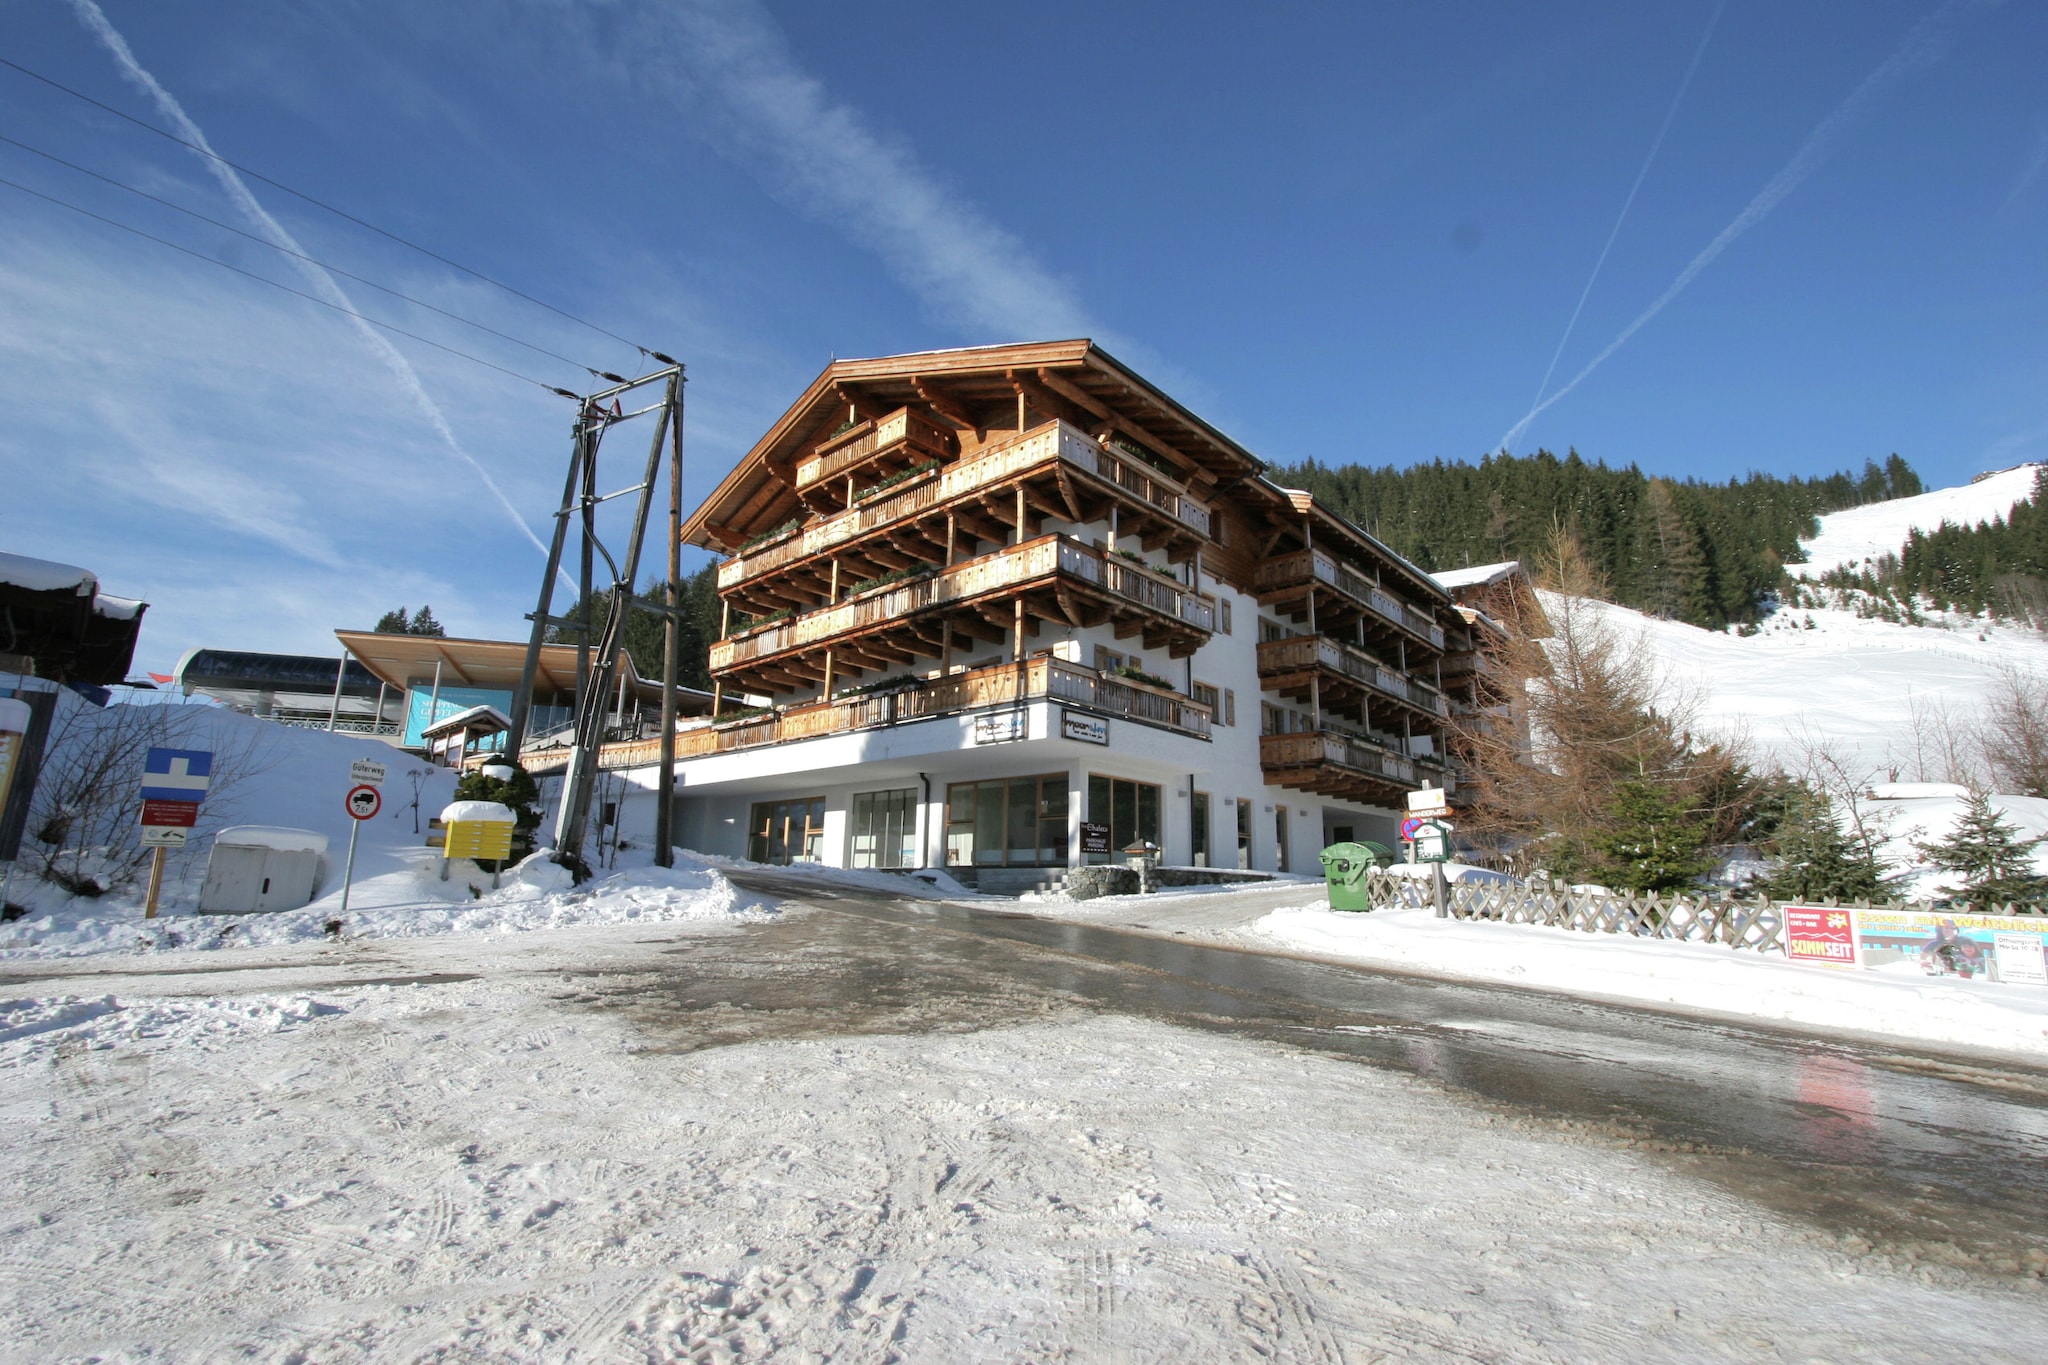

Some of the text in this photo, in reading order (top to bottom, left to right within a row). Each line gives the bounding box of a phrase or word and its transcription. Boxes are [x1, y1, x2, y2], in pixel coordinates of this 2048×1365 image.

[352, 762, 385, 776] Güterweg
[1409, 809, 1447, 818] WANDERWEG
[1856, 911, 2048, 933] Essen mit Weitblick
